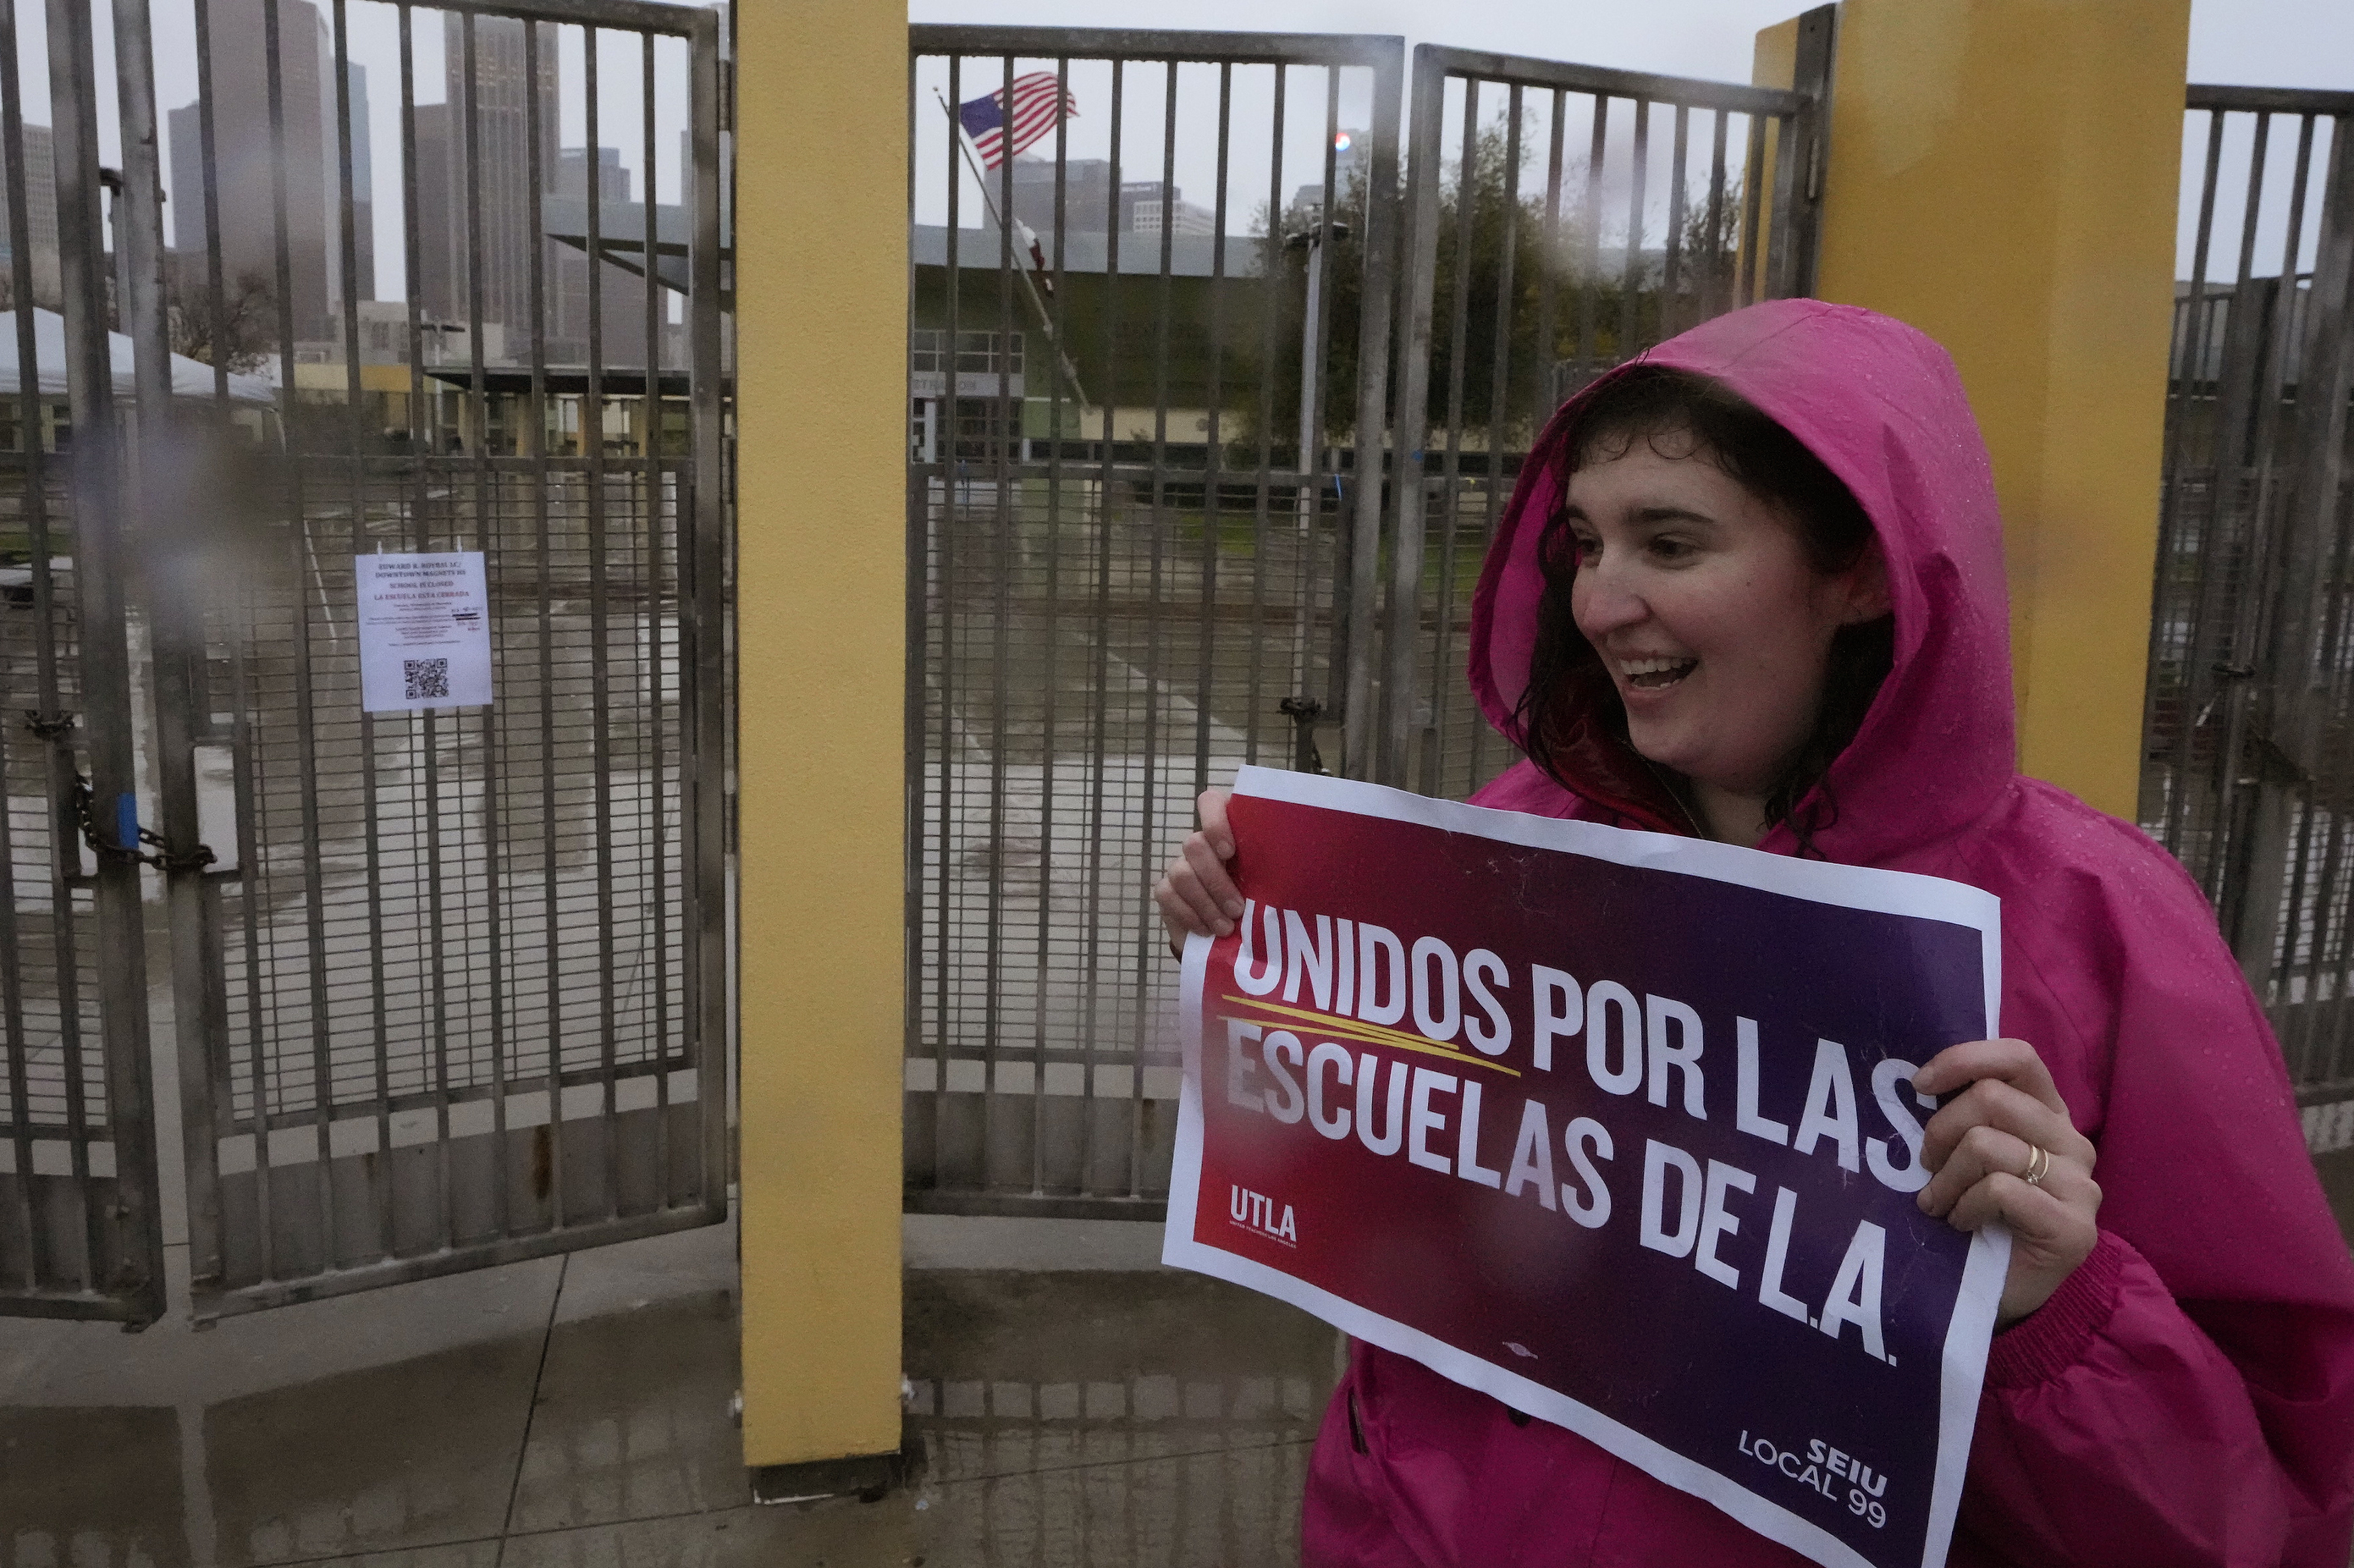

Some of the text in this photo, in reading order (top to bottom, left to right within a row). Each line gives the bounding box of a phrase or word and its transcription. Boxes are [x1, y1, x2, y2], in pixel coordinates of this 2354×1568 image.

[1232, 899, 1936, 1193] UNIDOS POR LAS
[1227, 1022, 1898, 1367] ESCUELAS DE L.A.
[1231, 1184, 1297, 1242] UTLA
[1738, 1429, 1886, 1528] LOCAL 99
[1806, 1439, 1888, 1498] SEIU
